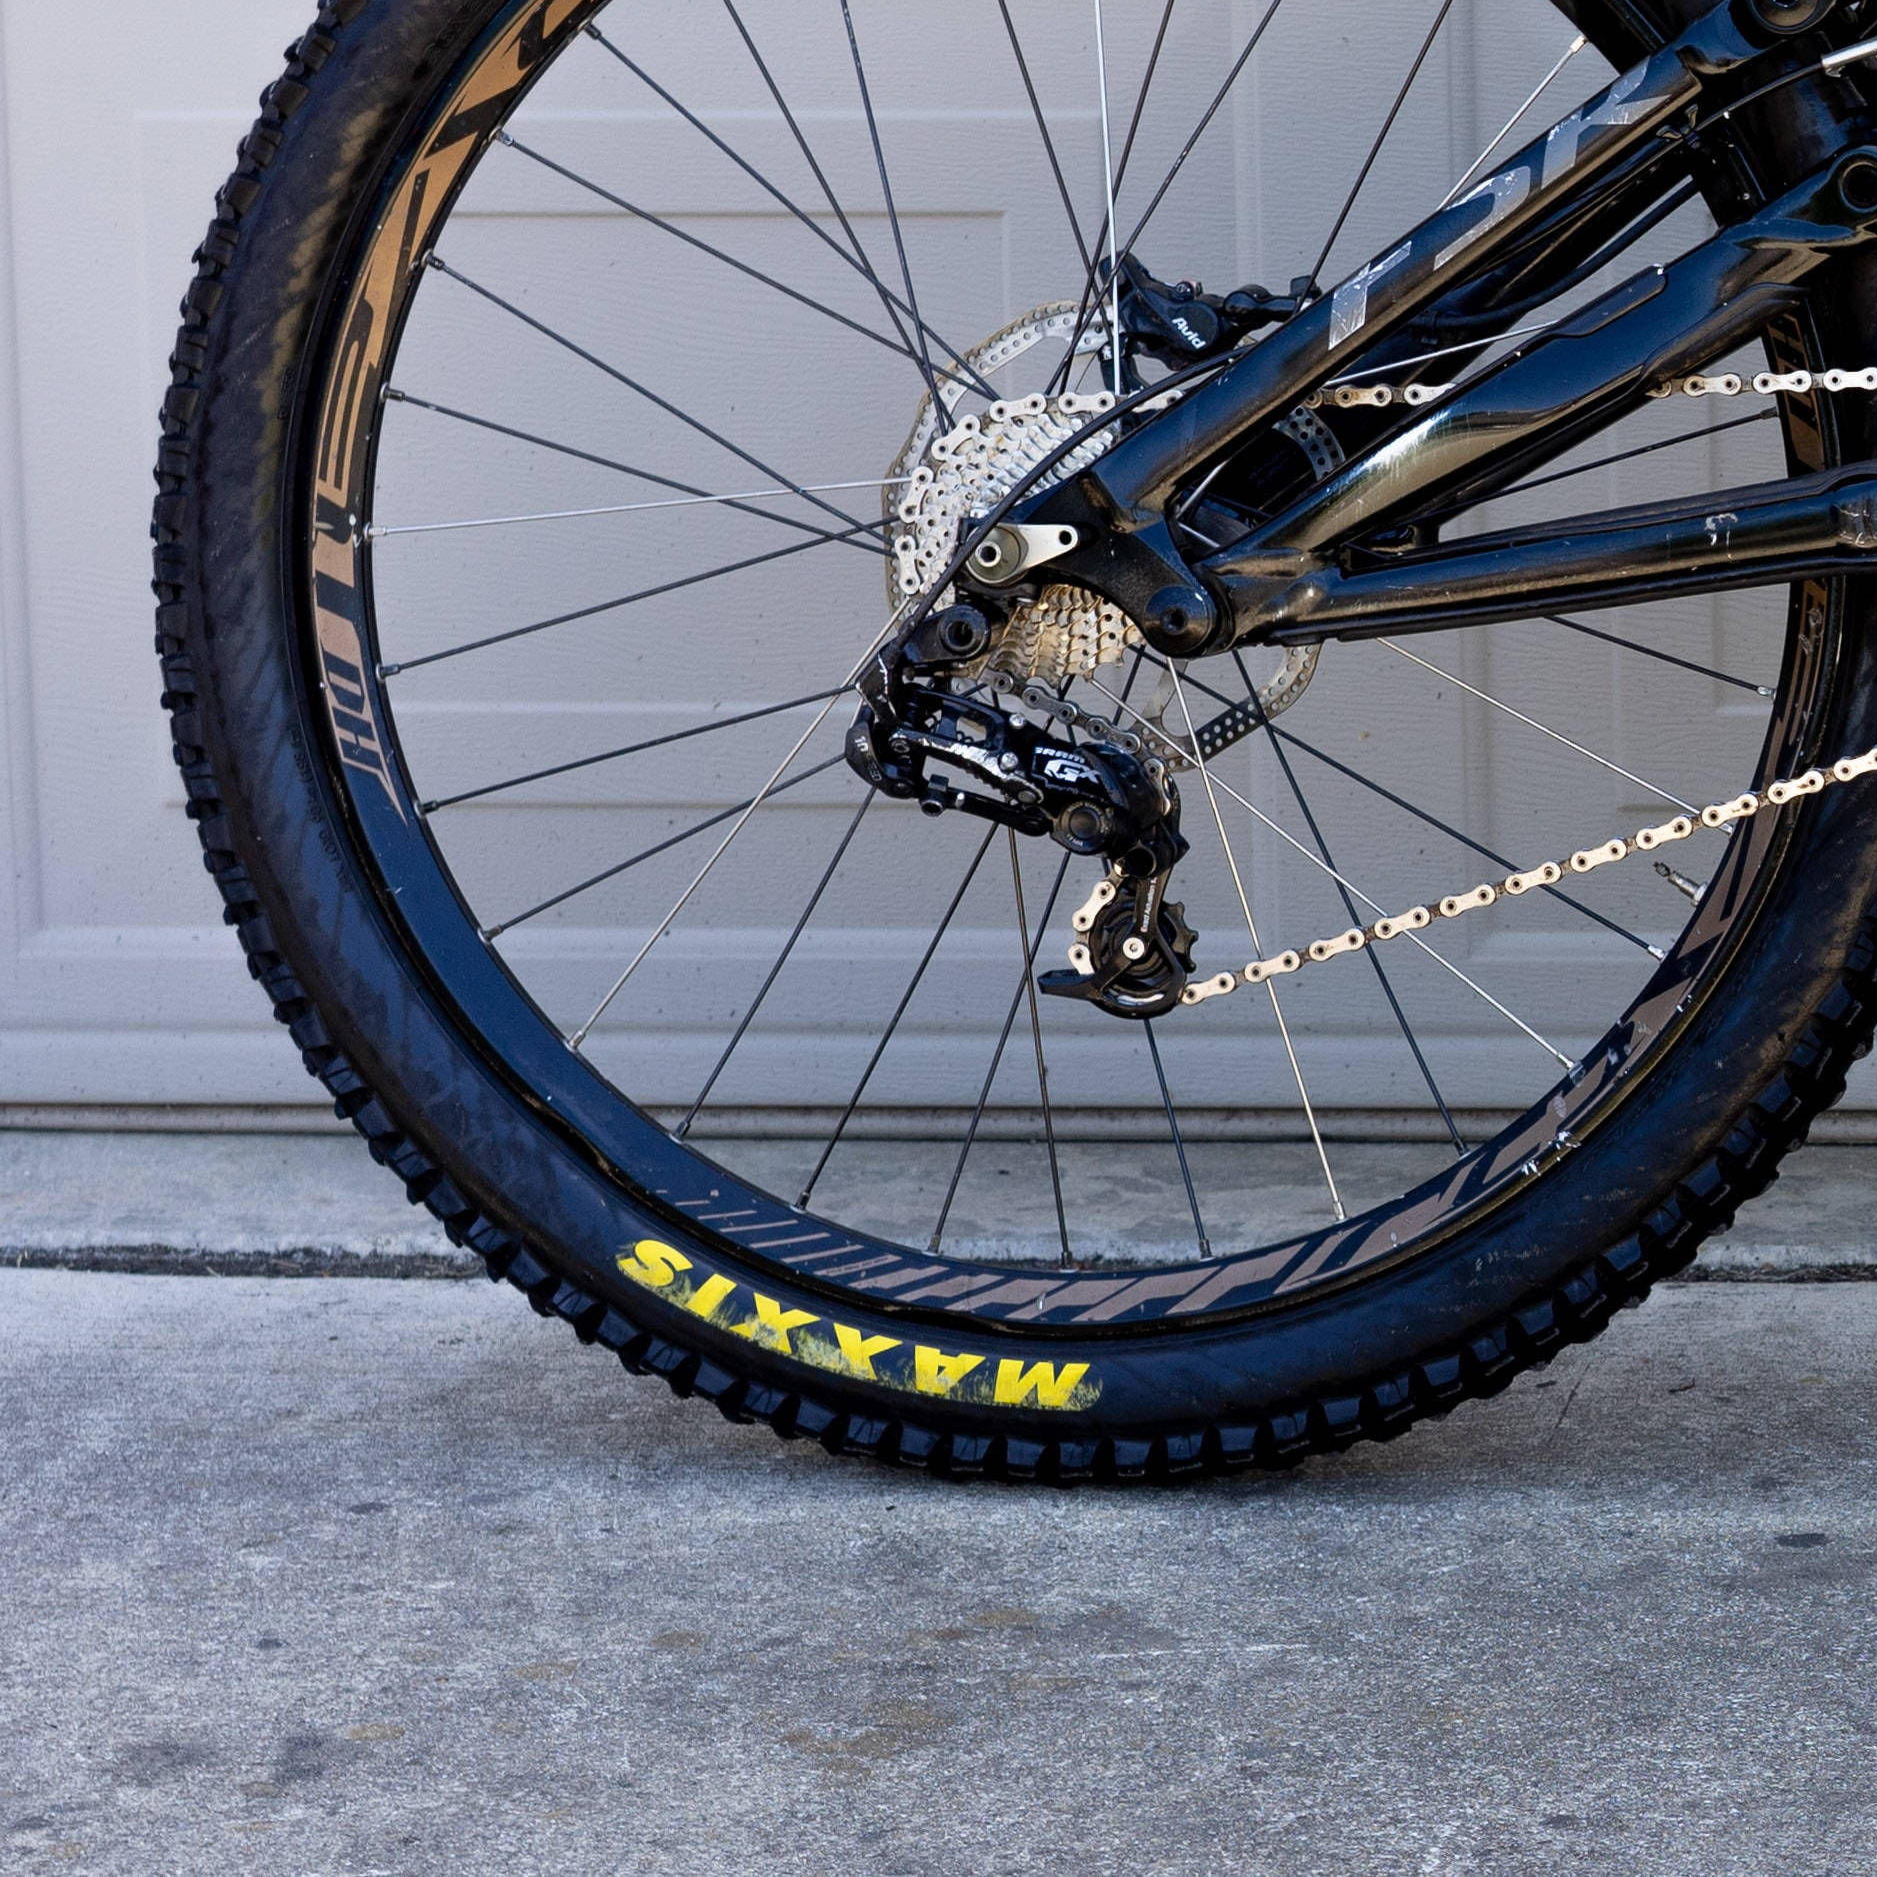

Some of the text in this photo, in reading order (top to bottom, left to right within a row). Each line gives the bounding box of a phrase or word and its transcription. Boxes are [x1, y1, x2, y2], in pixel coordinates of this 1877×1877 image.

[1171, 316, 1206, 351] Avid
[1045, 758, 1098, 783] GX
[615, 1237, 1098, 1412] MAXXIS
